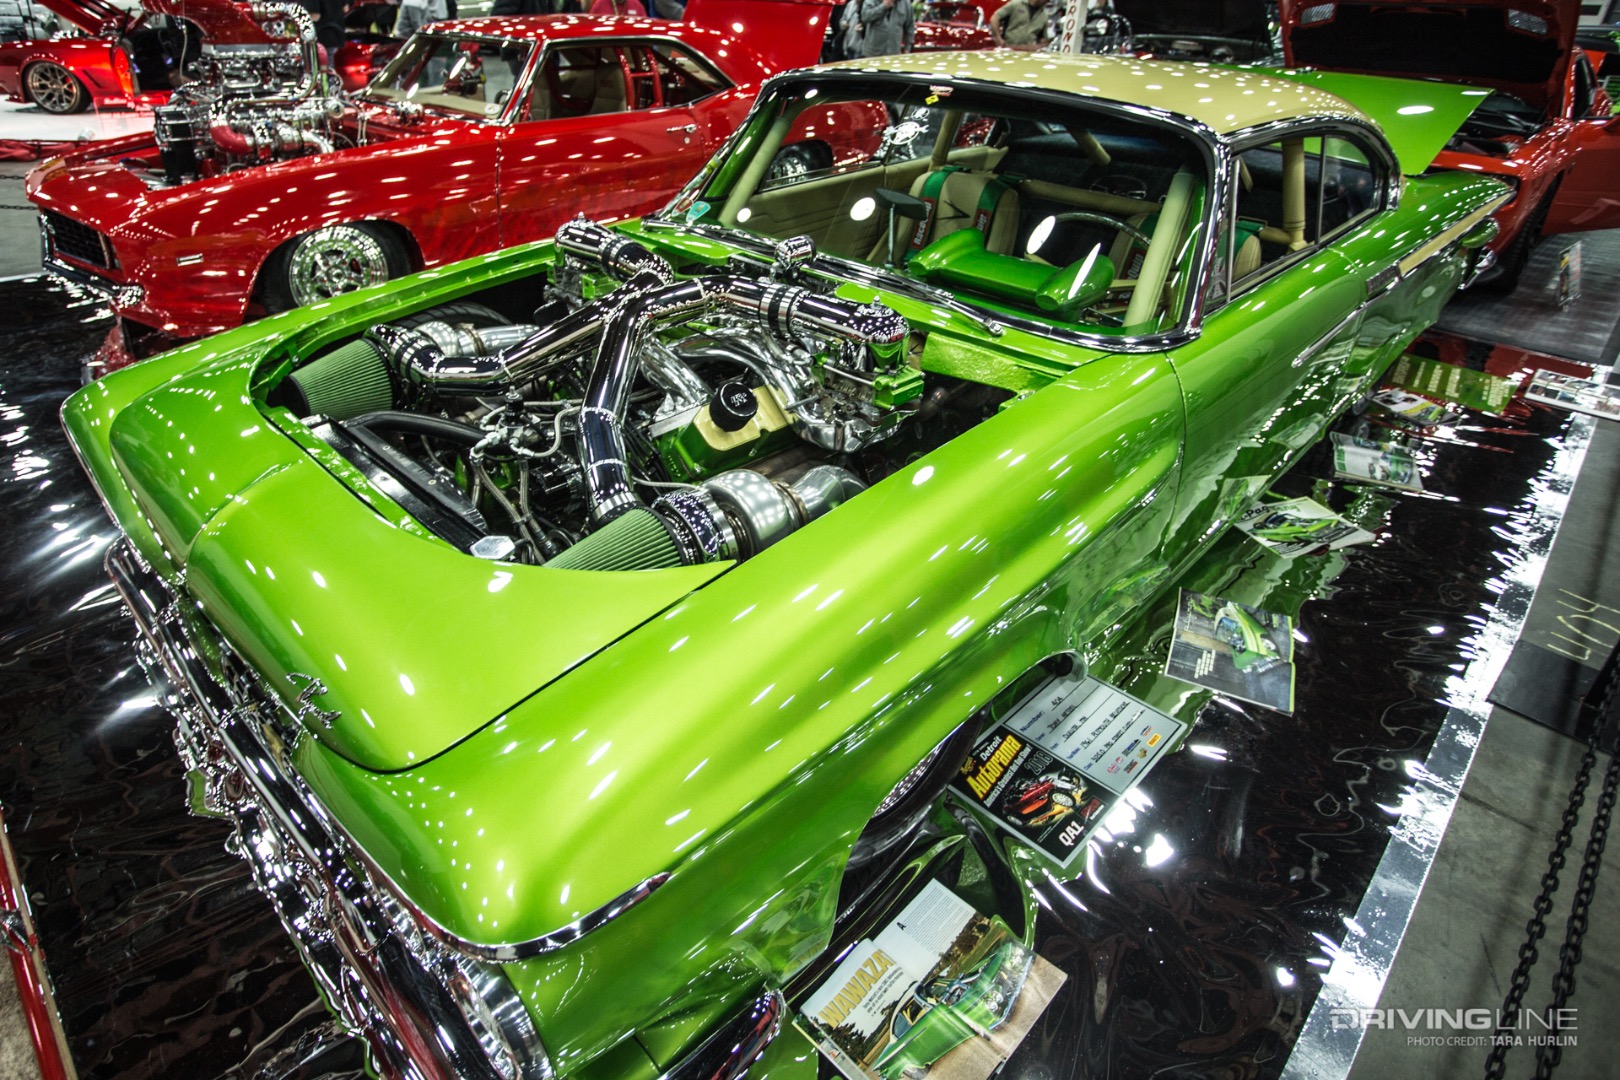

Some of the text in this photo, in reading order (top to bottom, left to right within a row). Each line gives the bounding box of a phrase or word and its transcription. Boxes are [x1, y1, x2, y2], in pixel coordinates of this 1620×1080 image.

[979, 735, 1002, 761] Detroit
[966, 734, 1022, 799] Autorama
[1058, 820, 1084, 846] QA1
